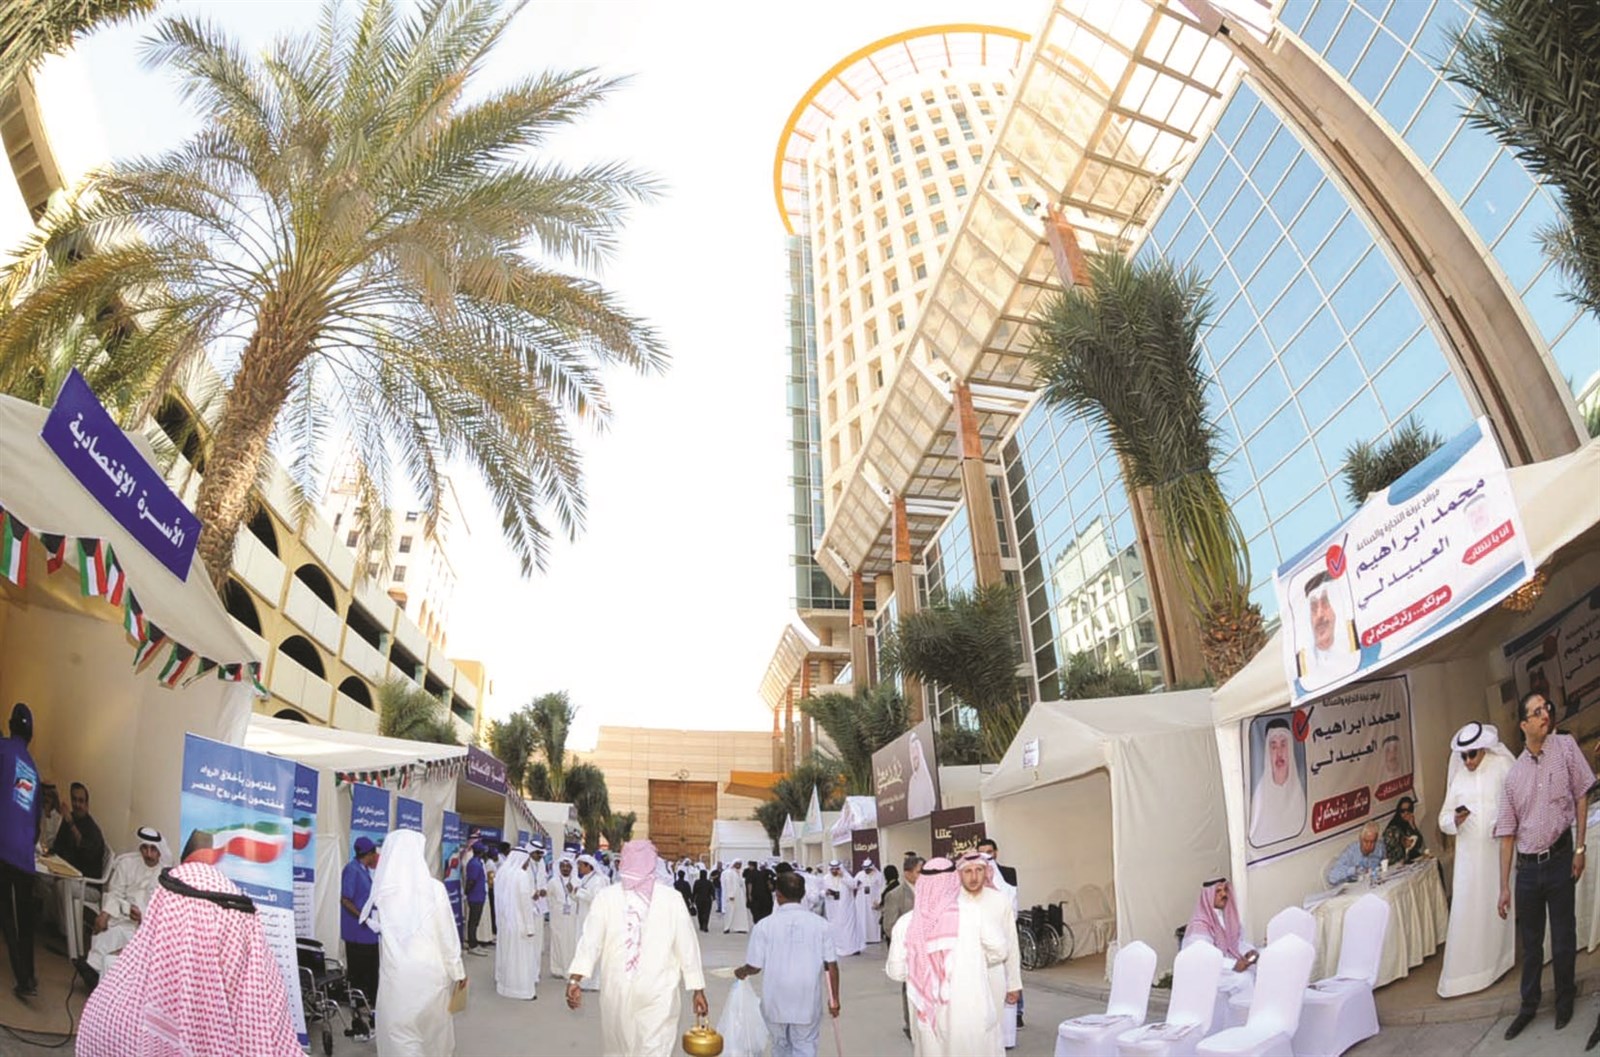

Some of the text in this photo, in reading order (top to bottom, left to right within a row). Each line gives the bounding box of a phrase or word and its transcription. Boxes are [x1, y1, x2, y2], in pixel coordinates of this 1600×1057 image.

[69, 412, 185, 548] الأسرة الإقتصادية
[1356, 478, 1485, 579] محمد ابراهيم
[1358, 535, 1450, 610] العبيدلي
[1311, 739, 1378, 775] العبيدلي
[1312, 711, 1401, 743] محمد ابراهيم
